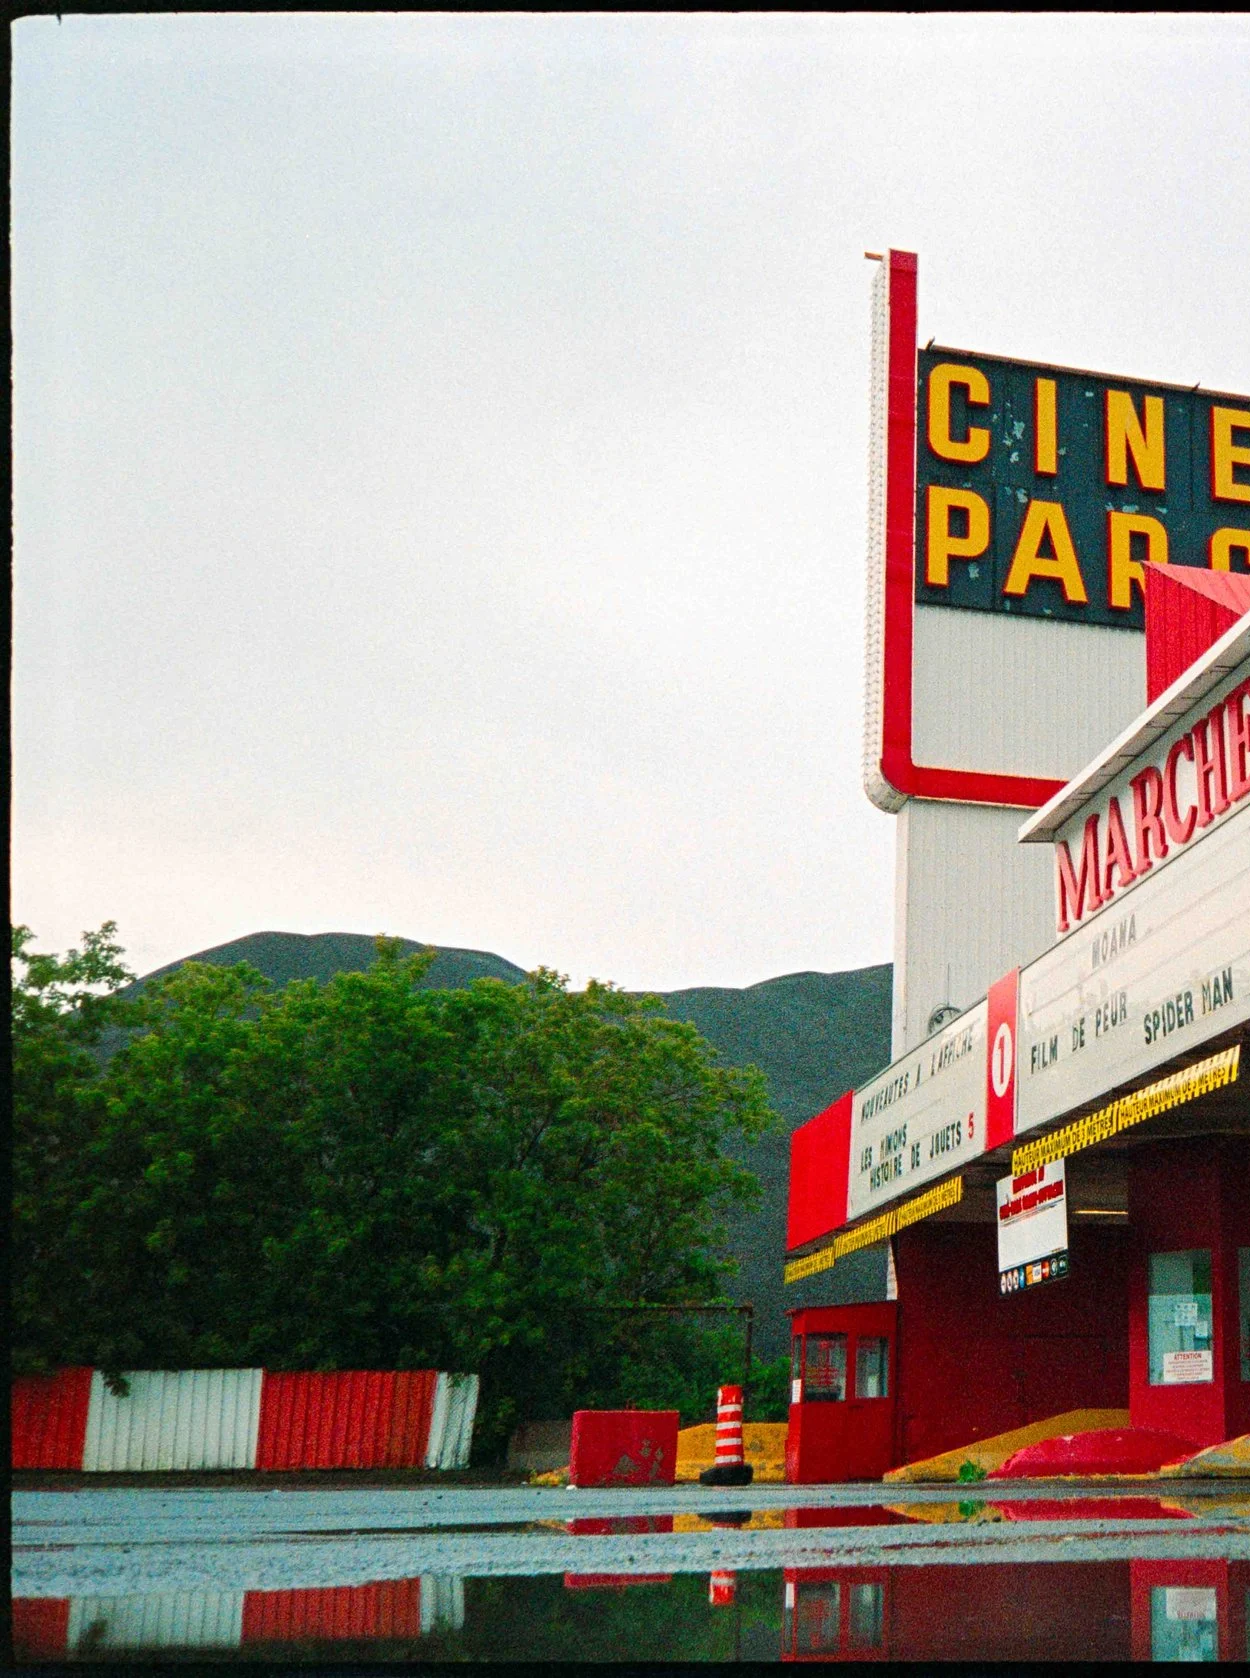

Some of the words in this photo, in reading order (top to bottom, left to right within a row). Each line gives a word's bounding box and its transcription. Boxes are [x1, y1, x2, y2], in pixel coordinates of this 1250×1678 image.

[1091, 914, 1137, 969] MOANA
[1143, 991, 1194, 1045] SPIDER
[1201, 967, 1234, 1015] MAN
[1030, 1034, 1058, 1075] FILM
[1072, 1017, 1086, 1051] DE
[1095, 991, 1128, 1037] PEUR
[997, 1036, 1005, 1085] 1
[1119, 1100, 1148, 1118] HAUTEUR
[861, 1146, 872, 1173] LES
[911, 1142, 920, 1169] DE
[930, 1120, 961, 1159] JOUETS
[968, 1112, 975, 1139] 5
[1173, 1352, 1202, 1360] ATTENTION
